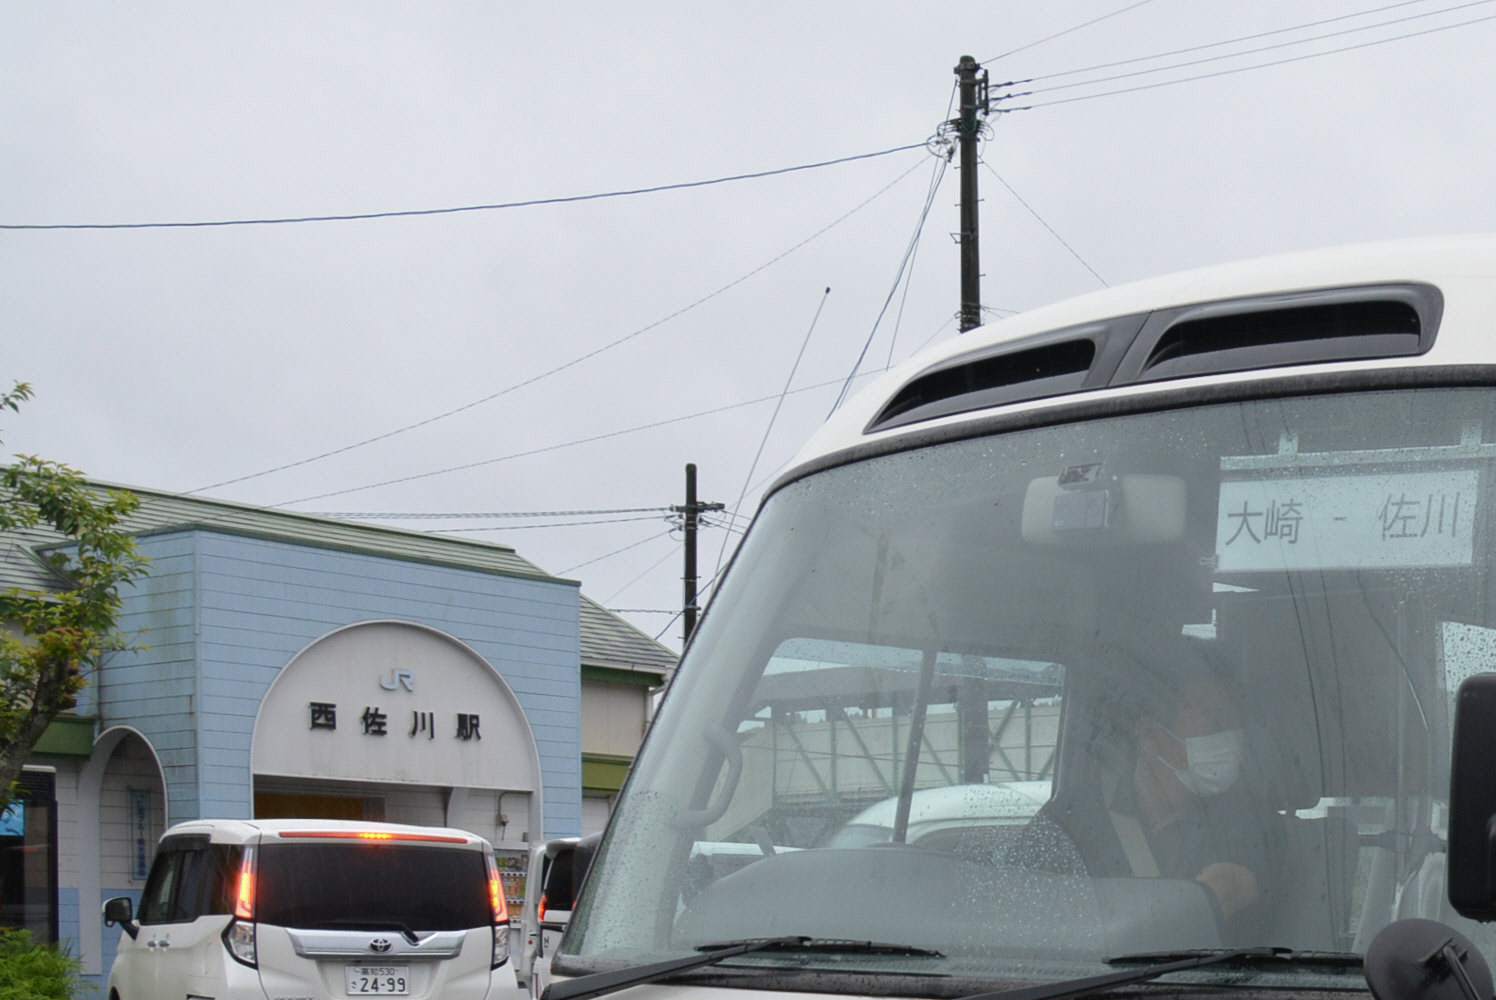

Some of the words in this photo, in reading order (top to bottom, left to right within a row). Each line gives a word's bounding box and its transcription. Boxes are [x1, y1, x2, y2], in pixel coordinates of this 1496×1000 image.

[1224, 498, 1305, 546] 大崎
[1378, 492, 1461, 541] 佐川
[379, 668, 416, 692] JR
[309, 701, 482, 741] 西佐川駅
[360, 977, 406, 992] 24-99
